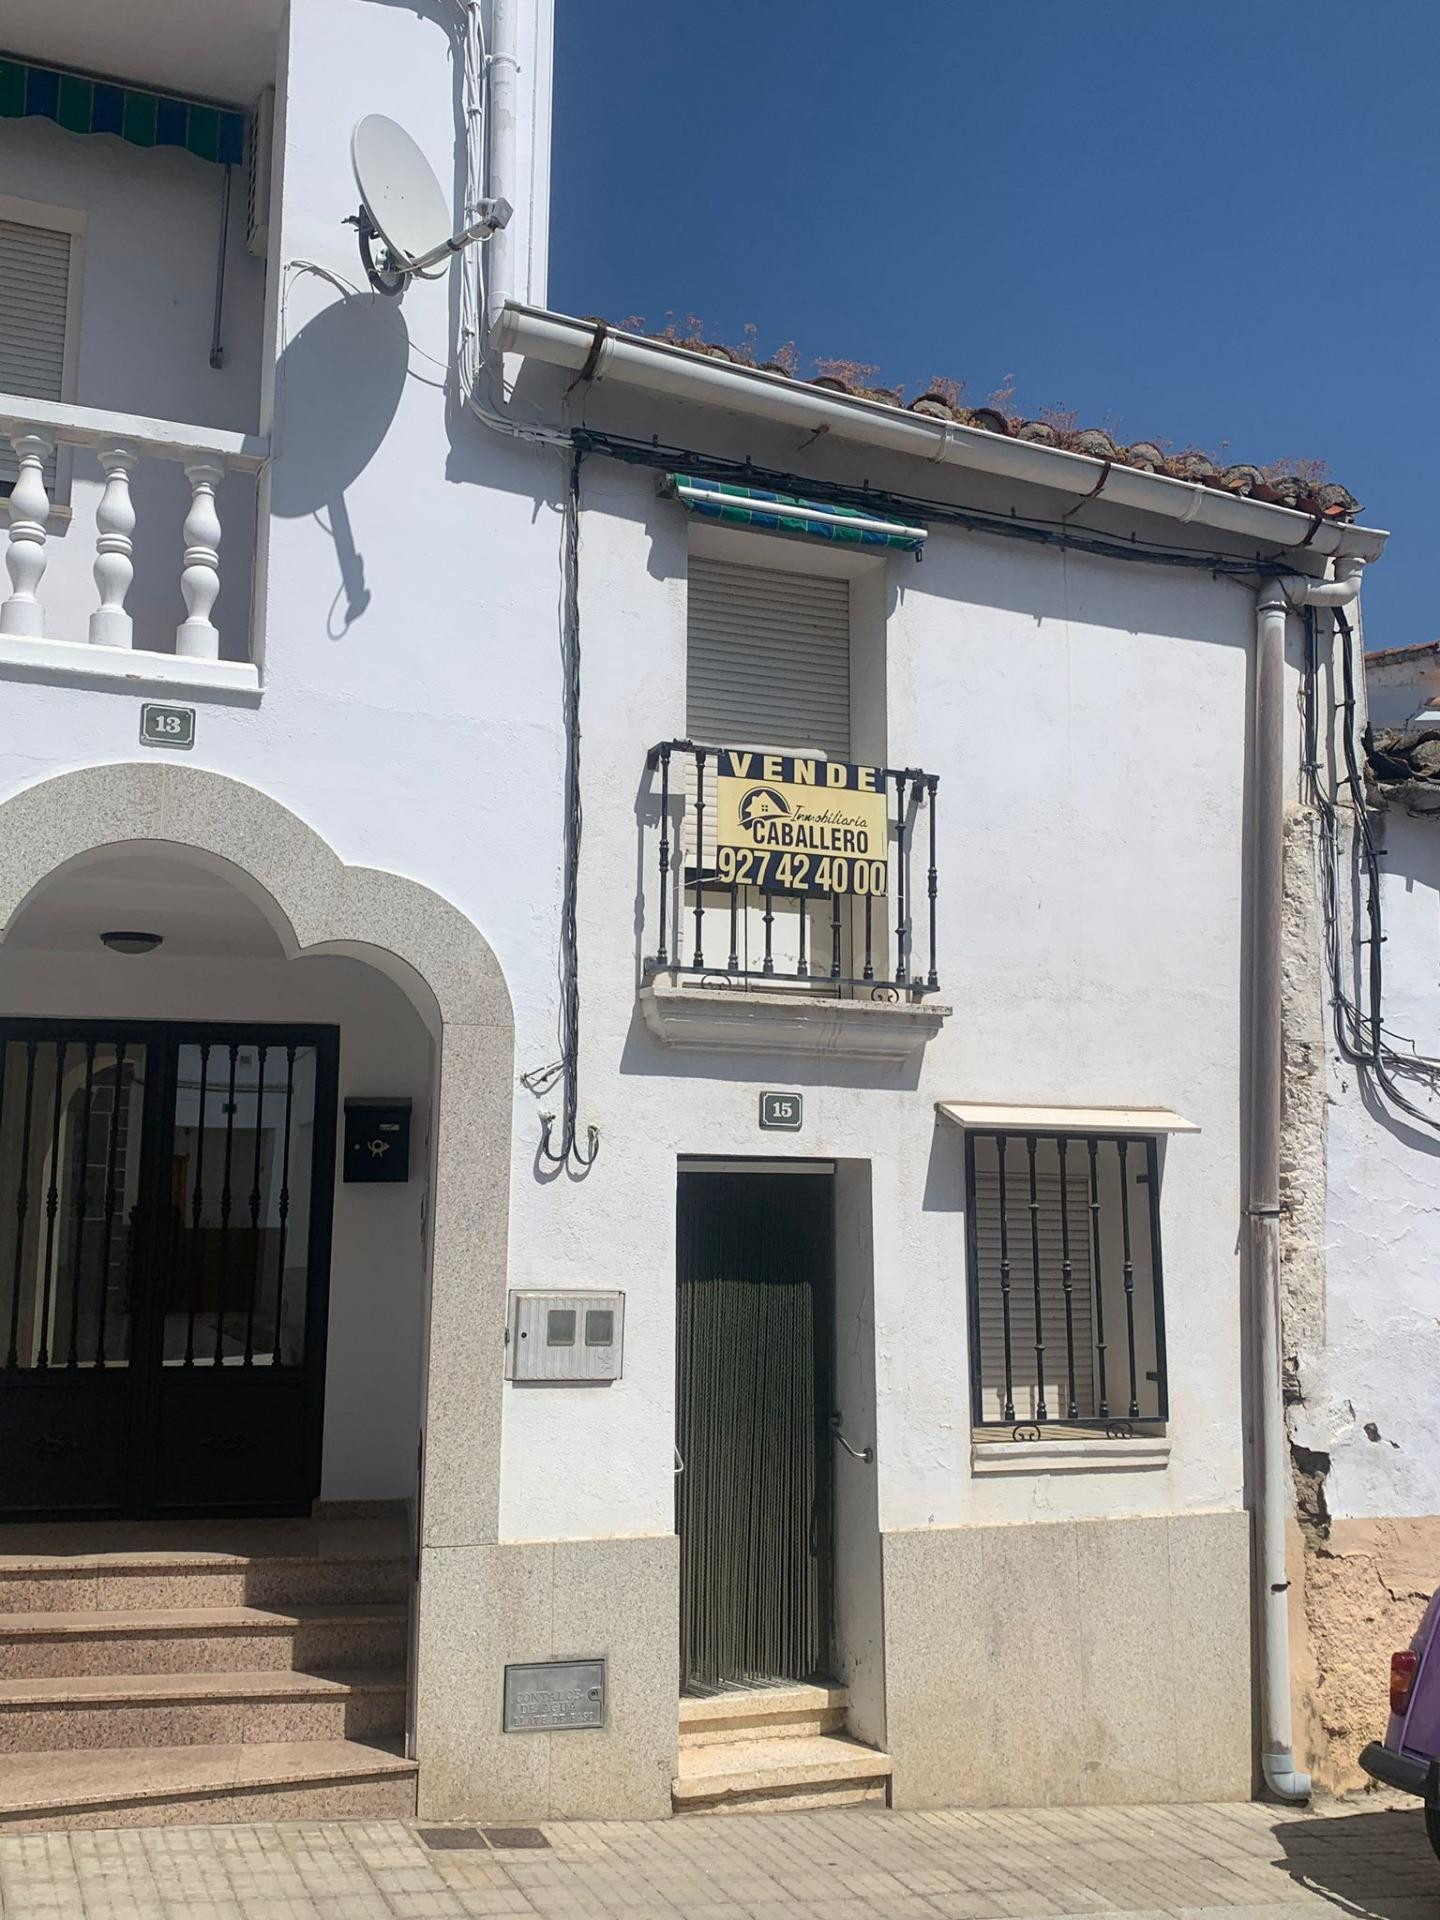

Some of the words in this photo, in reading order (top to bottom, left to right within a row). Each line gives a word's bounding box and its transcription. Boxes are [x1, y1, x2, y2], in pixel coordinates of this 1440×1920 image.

[155, 715, 181, 733] 13
[728, 751, 876, 792] VENDE
[790, 804, 869, 828] Inmobiliaria
[752, 820, 869, 854] CABALLERO
[718, 847, 771, 886] 927
[775, 853, 810, 890] 42
[814, 857, 848, 894] 40
[853, 860, 886, 896] 00
[772, 1102, 793, 1118] 15
